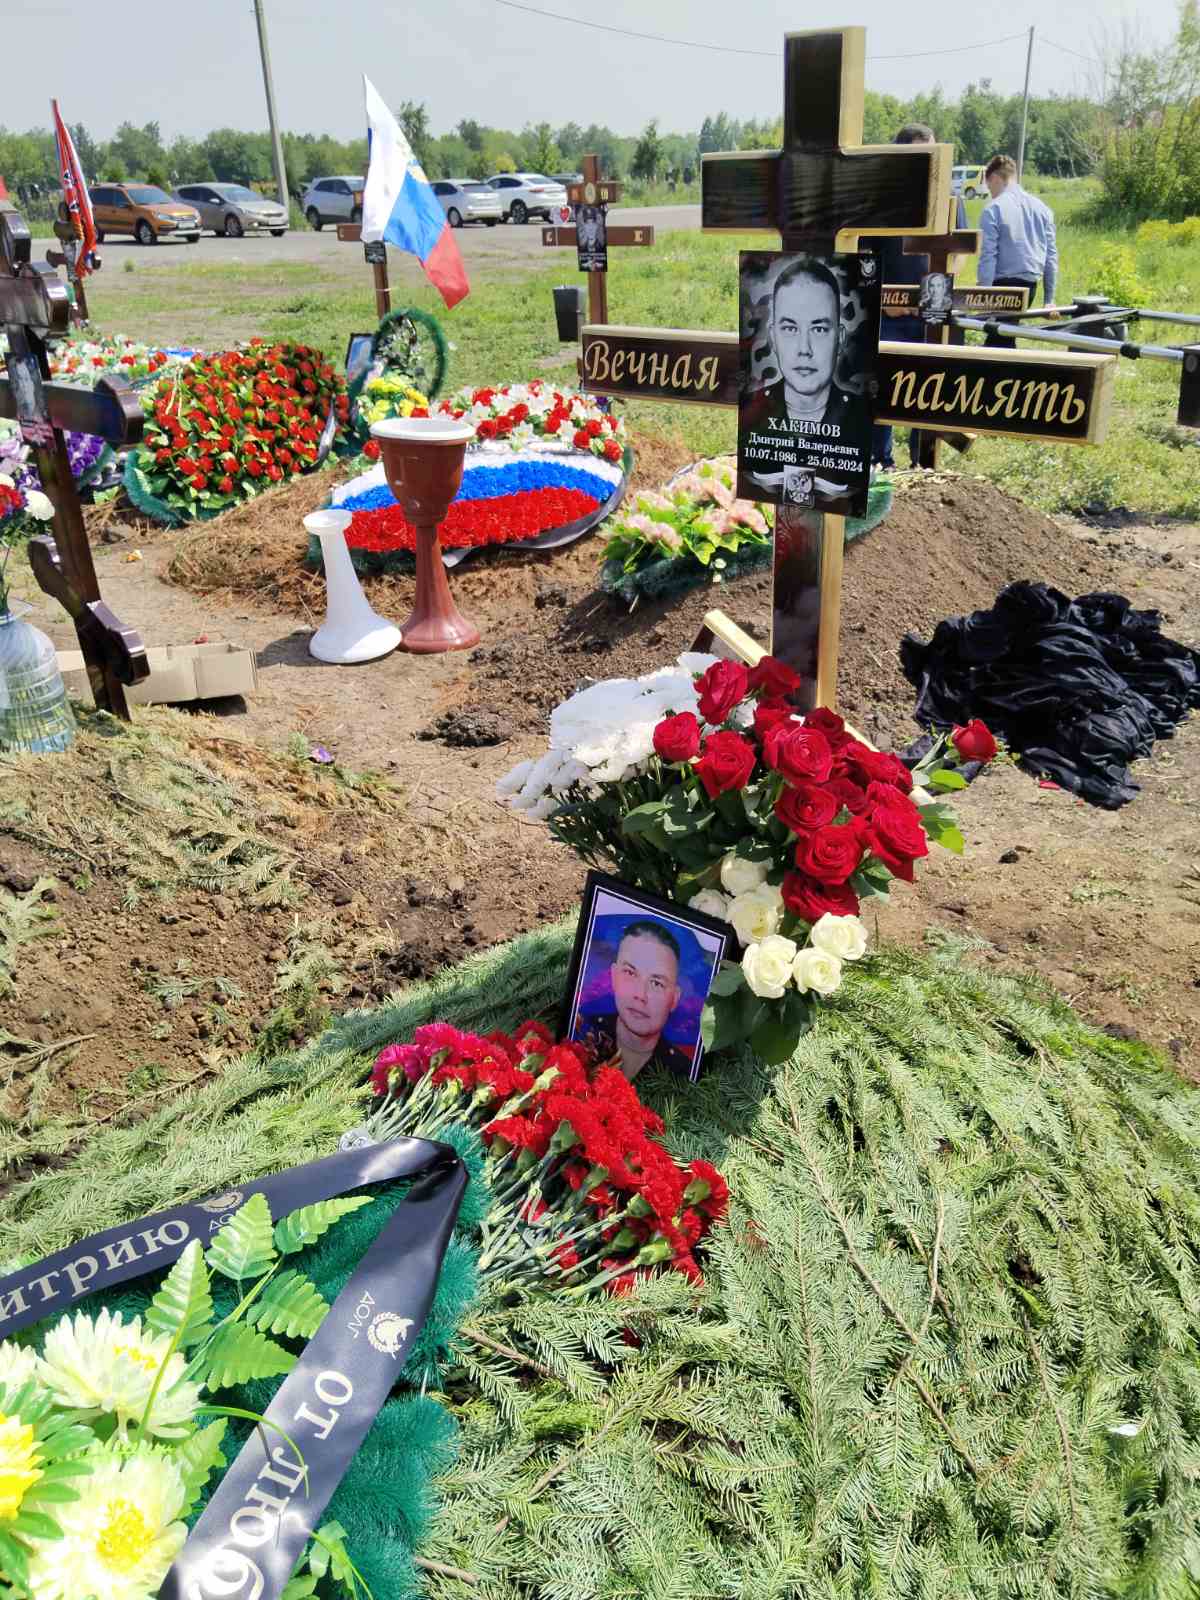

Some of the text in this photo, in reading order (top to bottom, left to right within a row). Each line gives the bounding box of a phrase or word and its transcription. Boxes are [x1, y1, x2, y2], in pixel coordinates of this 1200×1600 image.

[965, 293, 1022, 307] память
[584, 340, 1086, 424] Вечная память
[767, 417, 841, 438] ХАКИМОВ
[748, 432, 859, 456] Дмитрий Валерьевич
[744, 447, 797, 463] 10.07.1986
[807, 455, 863, 473] 25.05.2024
[0, 1220, 190, 1322] итрию
